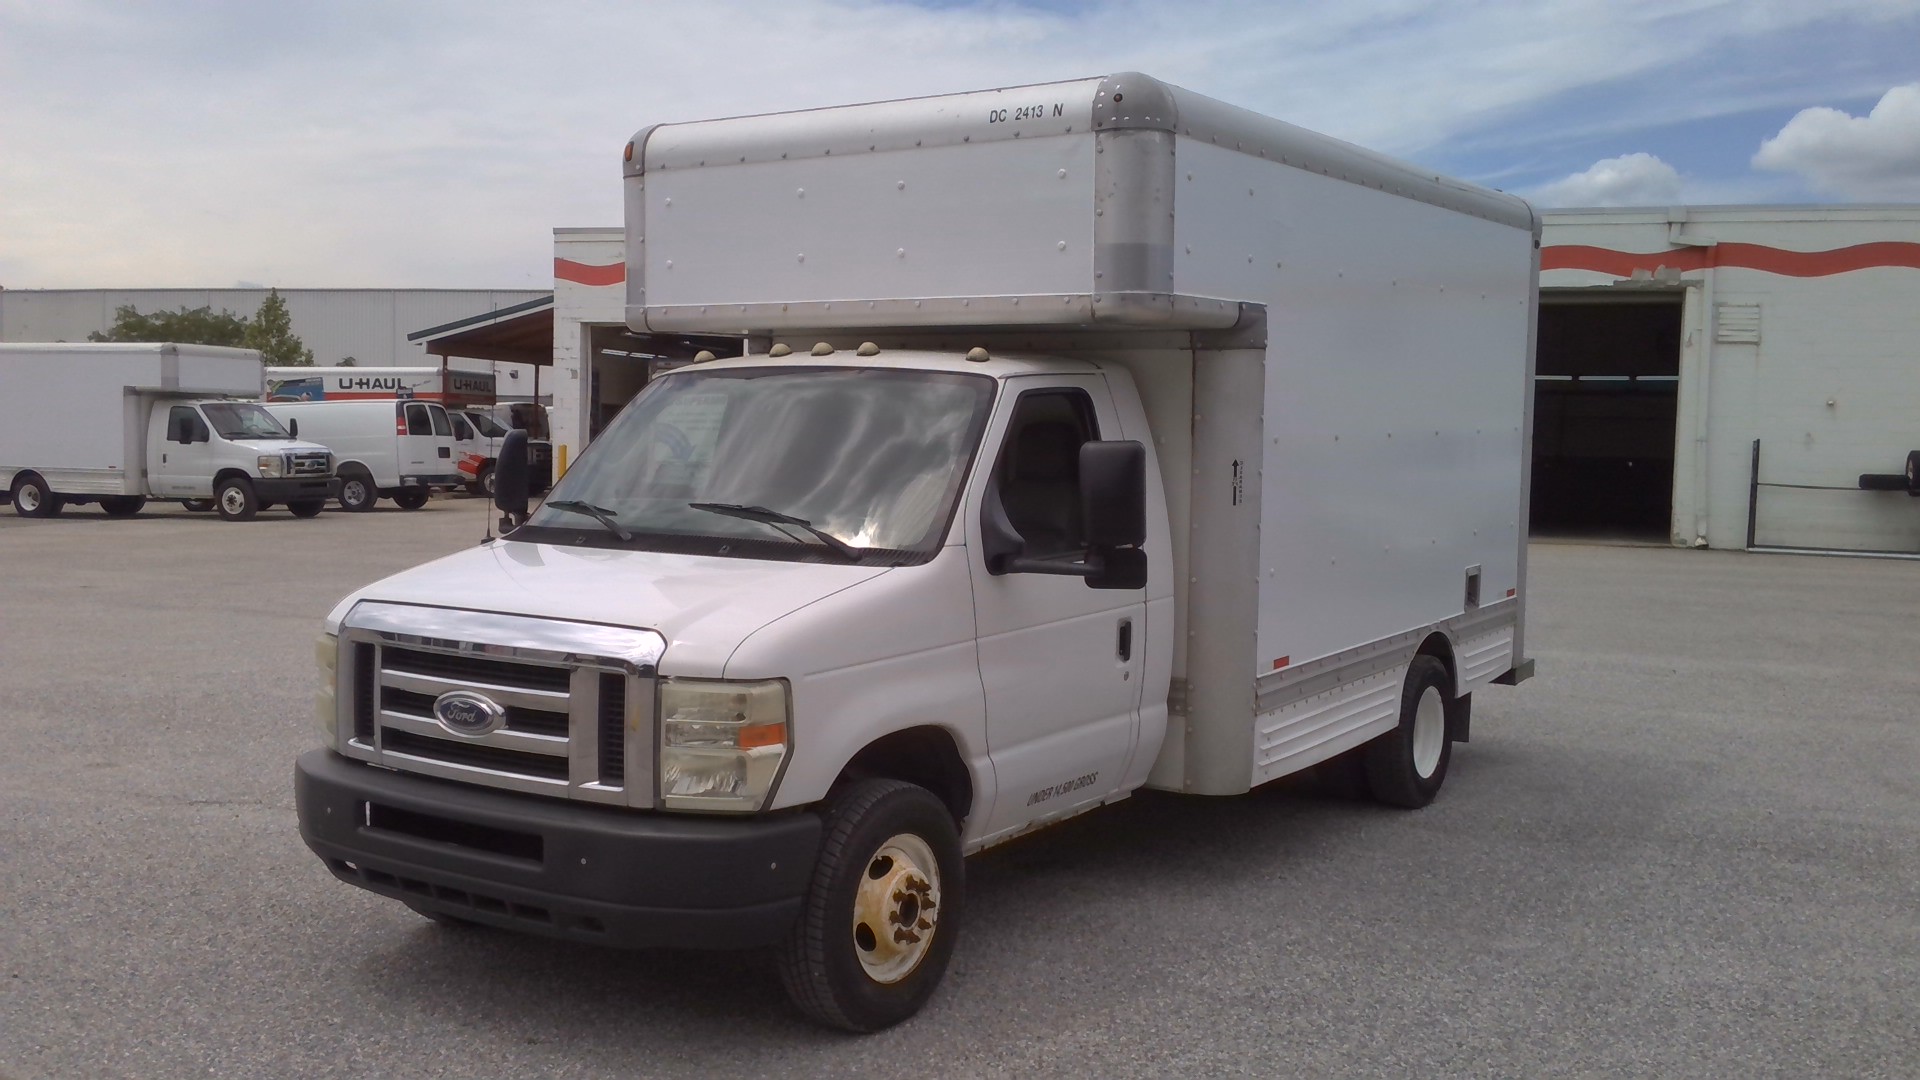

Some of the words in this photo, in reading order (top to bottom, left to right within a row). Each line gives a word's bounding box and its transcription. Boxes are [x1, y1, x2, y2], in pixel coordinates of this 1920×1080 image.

[989, 108, 1008, 124] DC
[1014, 104, 1044, 121] 2413
[1052, 102, 1065, 118] N
[338, 377, 407, 390] U-HAUL
[453, 378, 493, 393] U-HAUL
[447, 701, 478, 723] Ford
[1026, 786, 1054, 807] UNDER
